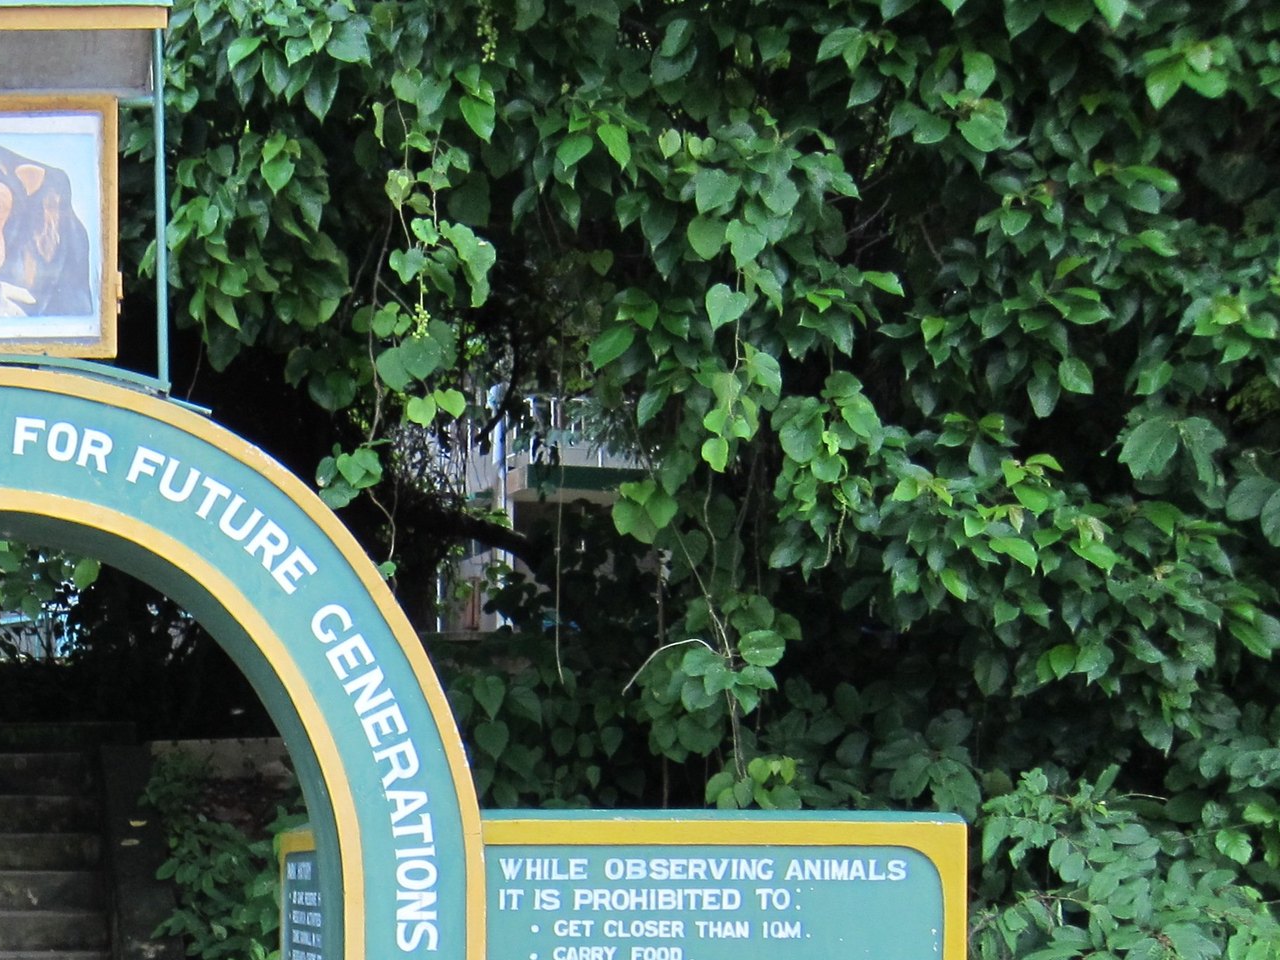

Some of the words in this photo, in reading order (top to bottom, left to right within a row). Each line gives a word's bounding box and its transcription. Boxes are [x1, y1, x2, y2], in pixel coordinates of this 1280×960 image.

[13, 417, 112, 473] FOR
[126, 446, 317, 594] FUTURE
[311, 604, 438, 951] GENERATIONS
[499, 858, 588, 882] WHILE
[604, 858, 774, 882] OBSERVING
[784, 858, 907, 882] ANIMALS
[499, 888, 525, 911] IT
[533, 888, 561, 911] IS
[573, 888, 741, 911] PROHIBITED
[755, 888, 802, 911] TO:
[553, 919, 595, 939] GET
[603, 919, 685, 939] CLOSER
[694, 919, 750, 939] THAN
